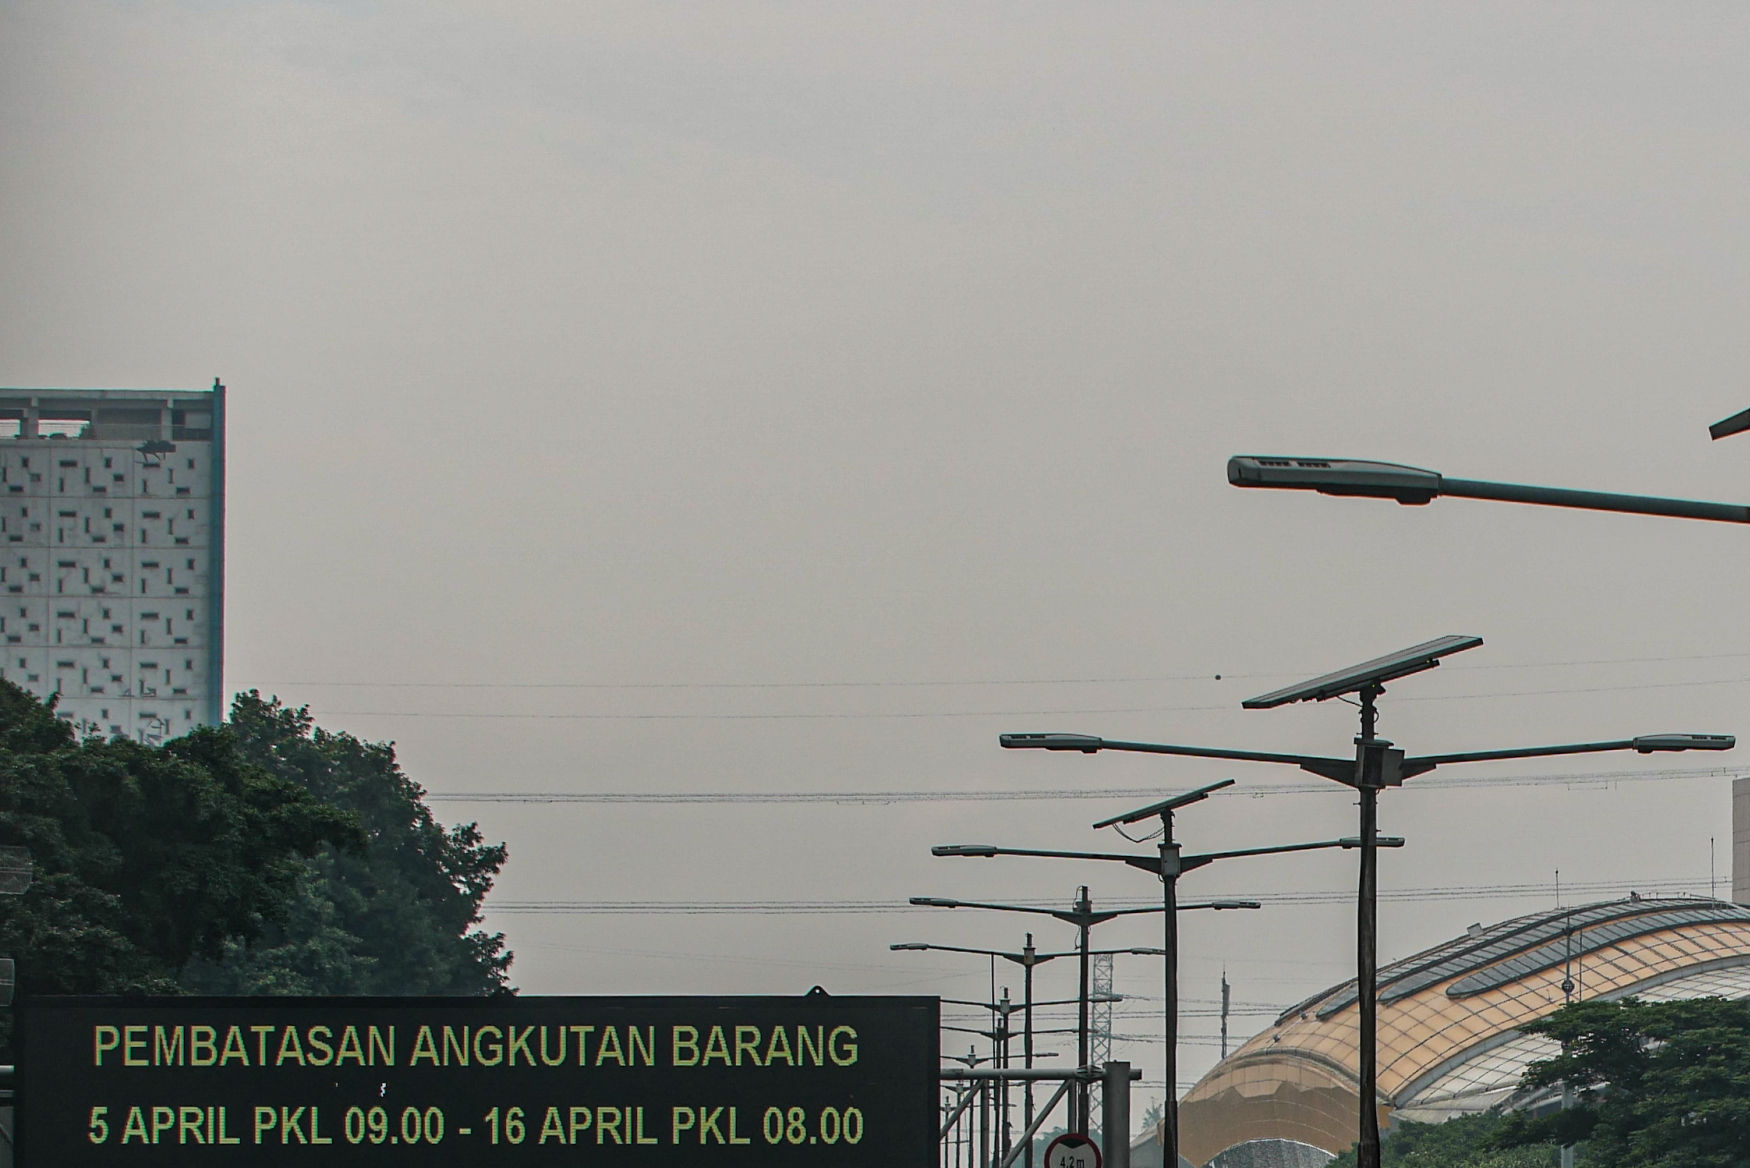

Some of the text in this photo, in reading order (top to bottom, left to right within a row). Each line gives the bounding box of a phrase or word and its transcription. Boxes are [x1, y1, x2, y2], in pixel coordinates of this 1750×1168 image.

[95, 1025, 858, 1067] PEMBATASAN ANGKUTAN BARANG
[89, 1106, 864, 1145] 5 APRIL PKL 09.00 - 16 APRIL PKL 08.00
